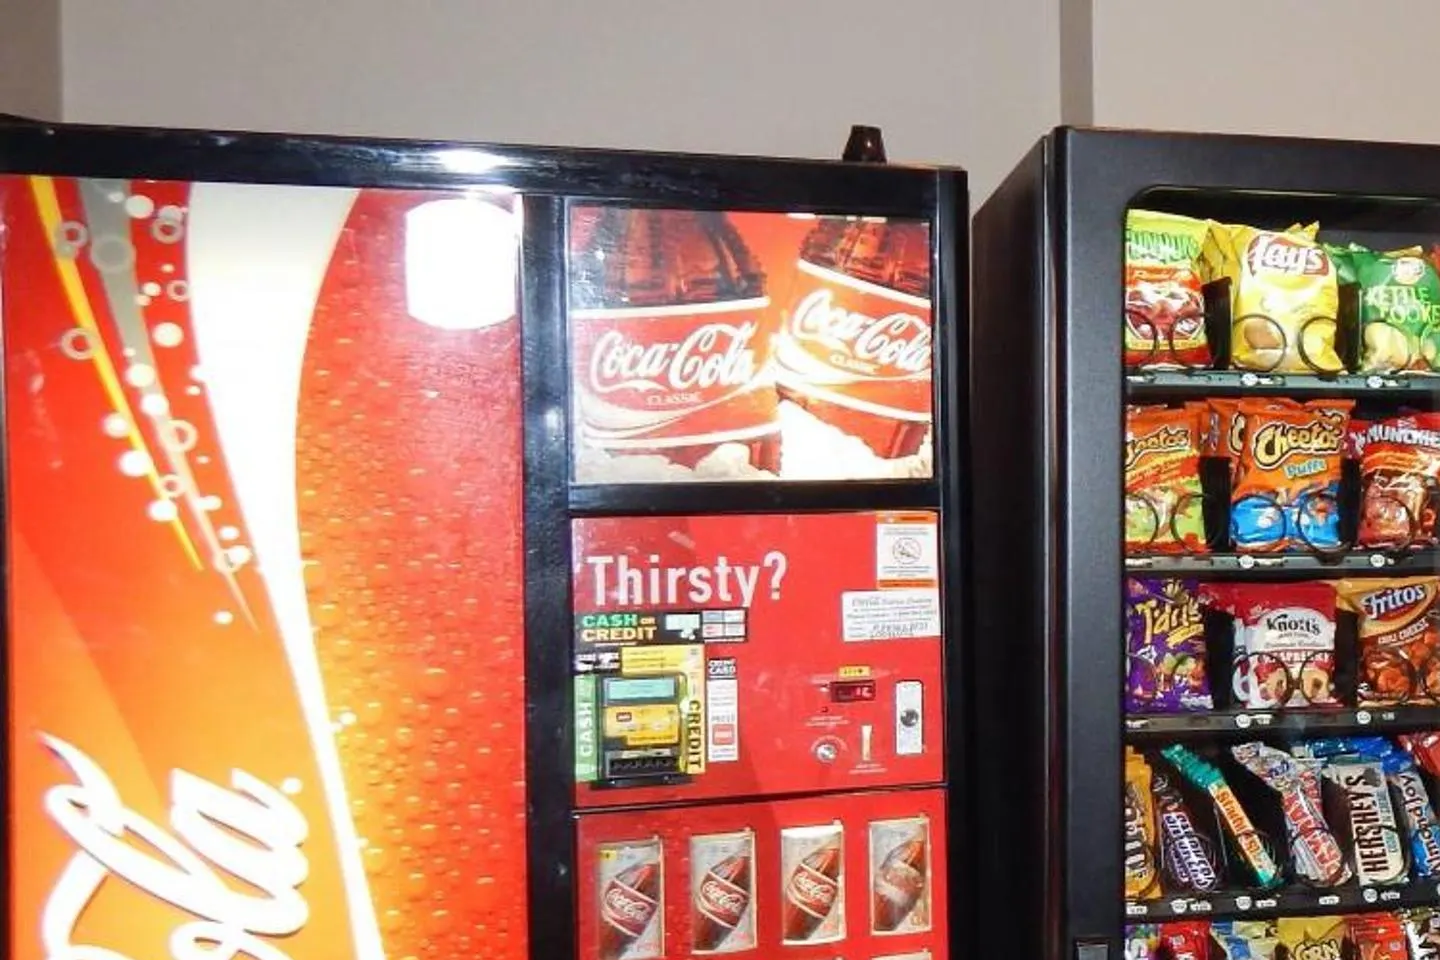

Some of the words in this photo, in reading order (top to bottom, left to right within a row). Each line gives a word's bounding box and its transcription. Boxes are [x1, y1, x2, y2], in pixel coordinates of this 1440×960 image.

[590, 321, 758, 393] Coca-Cola
[1253, 419, 1342, 468] Cheetos
[586, 550, 787, 607] Thirsty?
[1360, 584, 1426, 621] Fritos
[582, 614, 638, 628] CASH
[582, 626, 657, 642] CREDIT
[688, 699, 702, 769] CREDIT
[1400, 774, 1424, 807] Joy
[1344, 774, 1389, 874] HERSHEY'S
